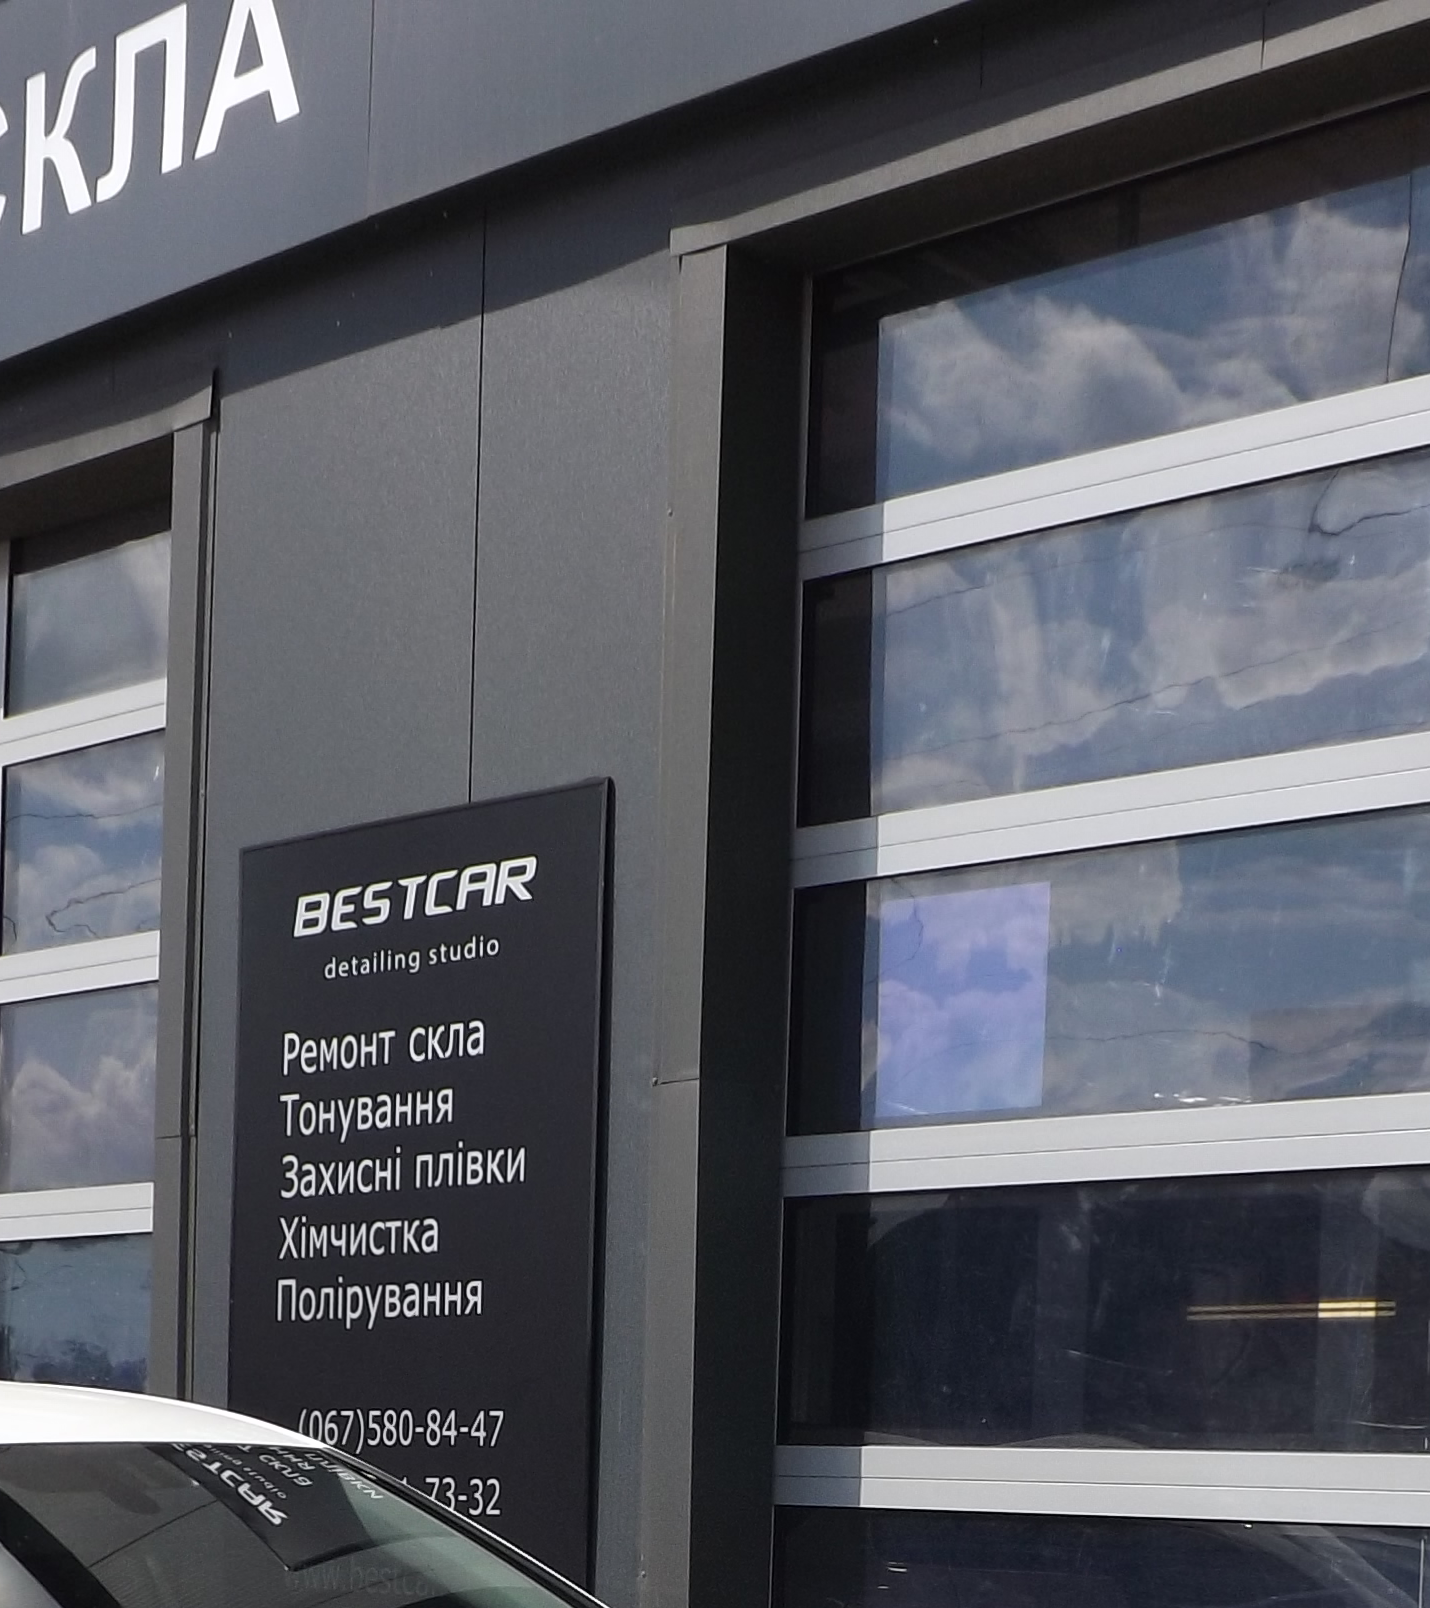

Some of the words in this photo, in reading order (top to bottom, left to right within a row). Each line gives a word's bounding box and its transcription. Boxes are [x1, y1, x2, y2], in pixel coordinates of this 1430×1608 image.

[292, 855, 538, 938] BESTCAR
[323, 949, 421, 980] detailing
[428, 935, 501, 965] studio
[282, 1028, 396, 1076] Ремонт
[408, 1018, 485, 1063] скла
[278, 1087, 454, 1144] Тонування
[279, 1146, 402, 1200] Захисні
[414, 1140, 527, 1188] плівки
[277, 1215, 439, 1260] Хімчистка
[276, 1275, 484, 1331] Полірування
[297, 1407, 505, 1455] (067)580-84-47
